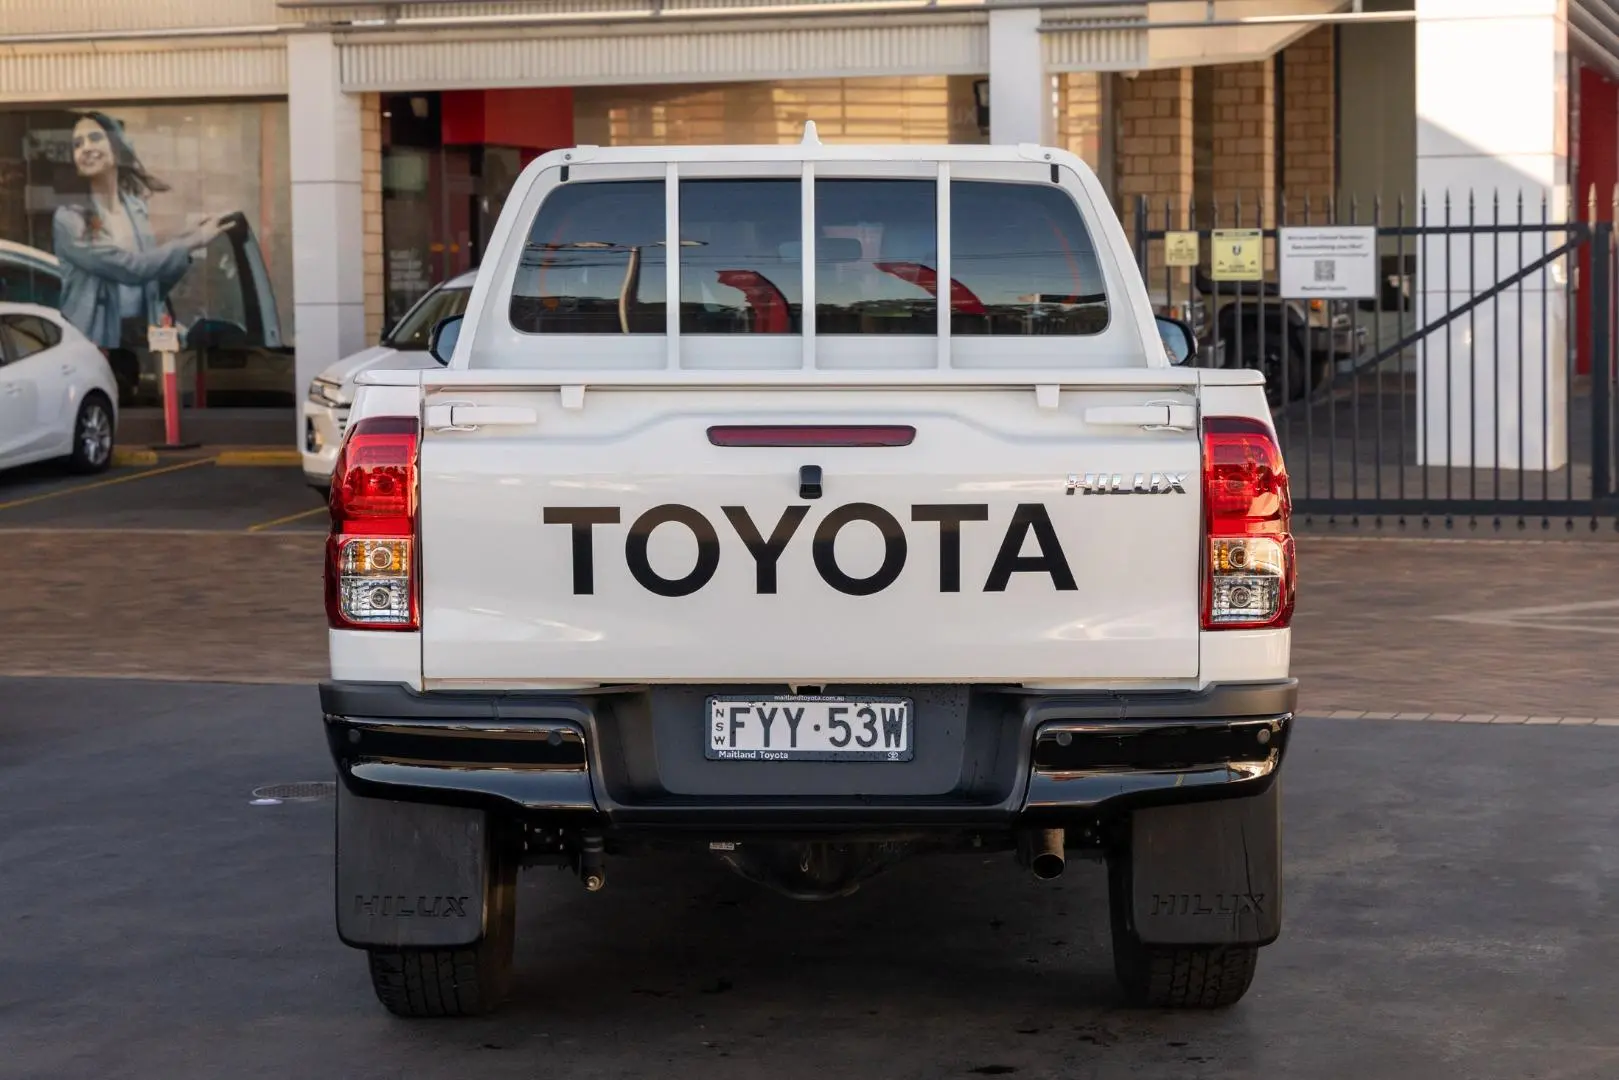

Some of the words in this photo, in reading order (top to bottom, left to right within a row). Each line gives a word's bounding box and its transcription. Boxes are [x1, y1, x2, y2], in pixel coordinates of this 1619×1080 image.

[1066, 473, 1190, 495] HILUX
[543, 502, 1078, 597] TOYOTA
[719, 751, 756, 759] Maitland
[760, 751, 789, 760] Toyota
[355, 895, 470, 918] HILUX
[1150, 894, 1265, 915] HILUX
